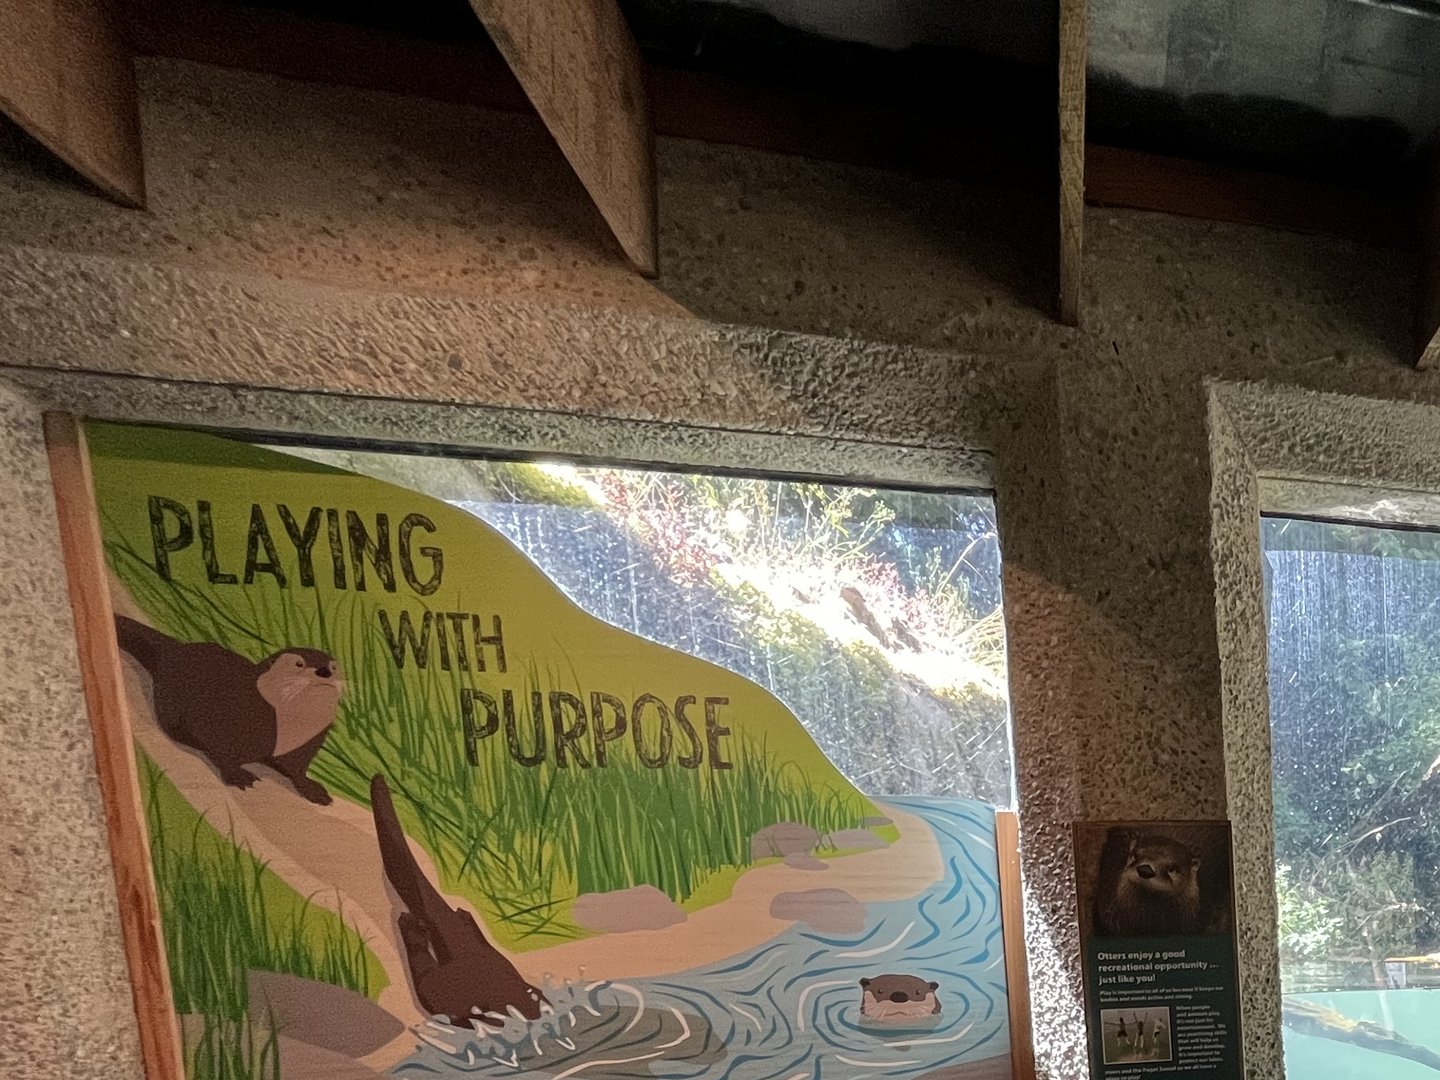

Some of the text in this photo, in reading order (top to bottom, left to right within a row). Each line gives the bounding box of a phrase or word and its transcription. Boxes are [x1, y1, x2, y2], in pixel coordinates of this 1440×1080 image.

[146, 496, 444, 595] PLAYING
[378, 610, 507, 674] WITH
[459, 688, 735, 771] PURPOSE
[1098, 963, 1152, 971] recreational
[1155, 961, 1207, 971] opportunity
[1128, 952, 1153, 960] enjoy
[1162, 950, 1185, 959] good
[1099, 976, 1116, 985] just
[1137, 974, 1155, 984] you!
